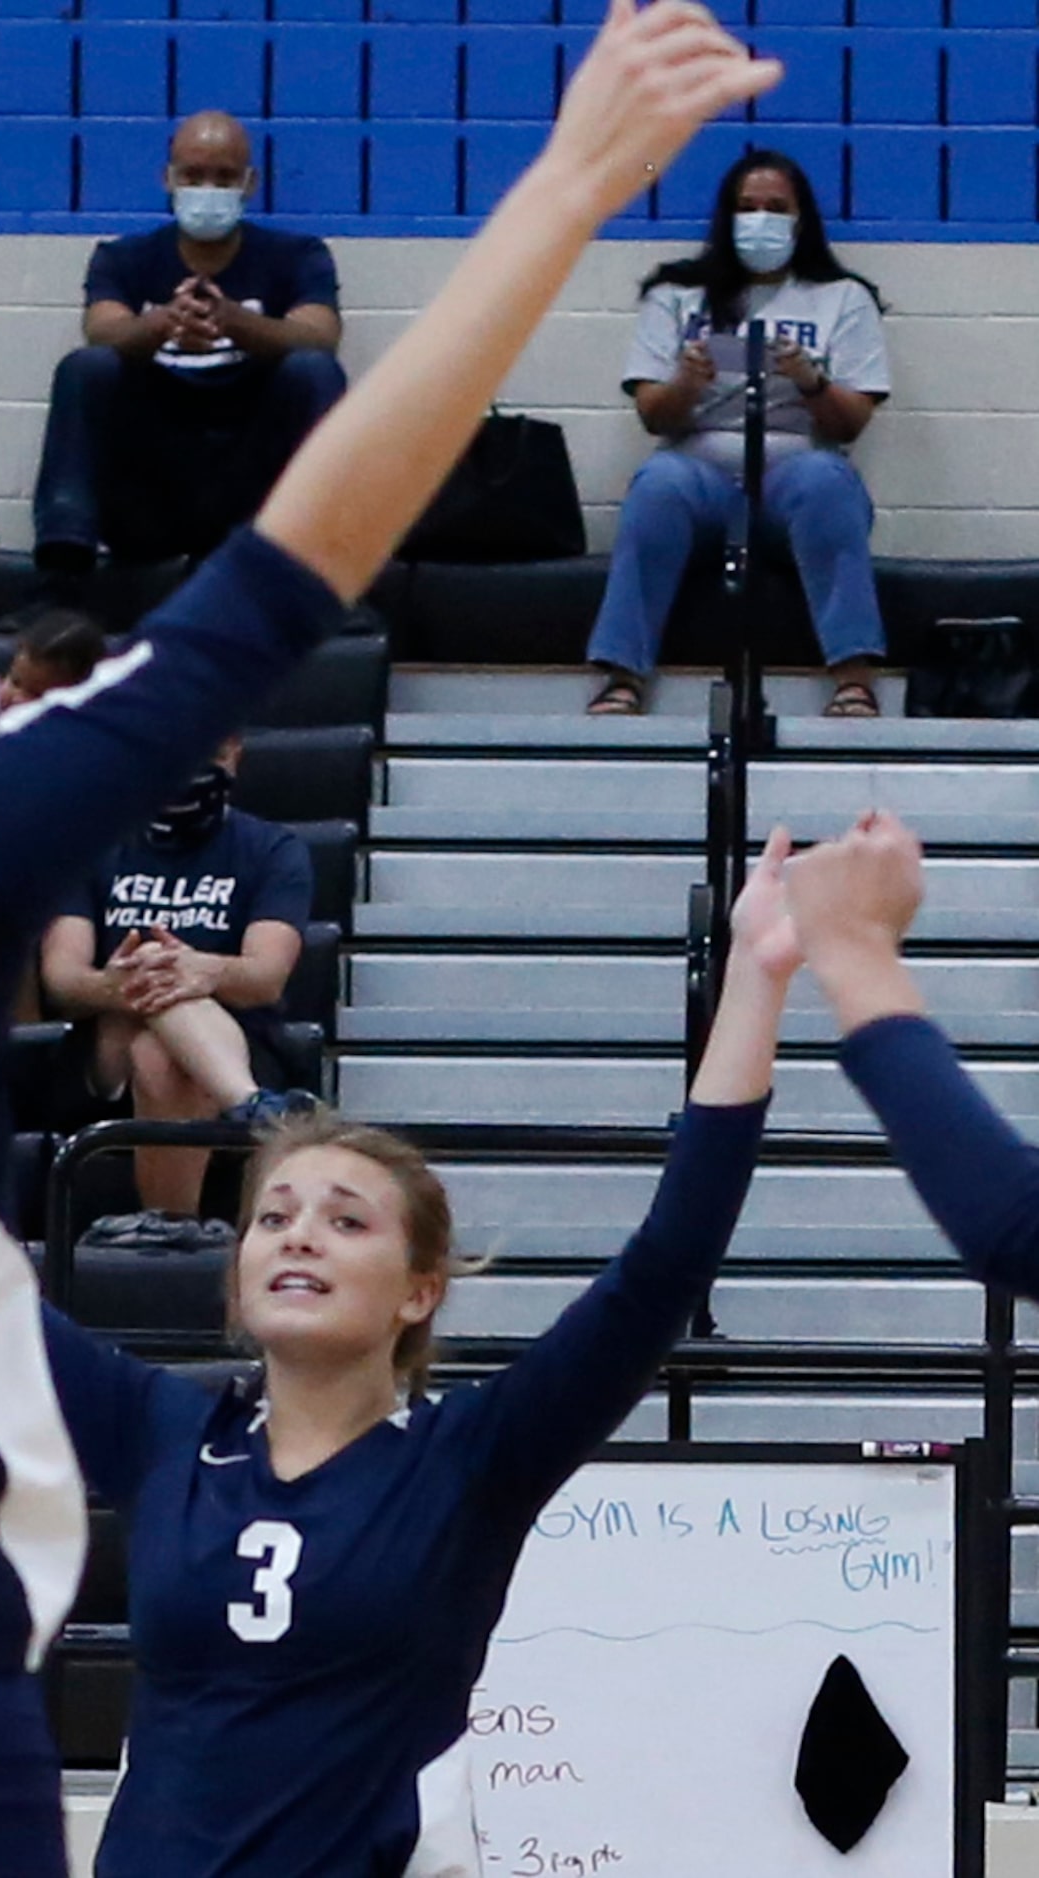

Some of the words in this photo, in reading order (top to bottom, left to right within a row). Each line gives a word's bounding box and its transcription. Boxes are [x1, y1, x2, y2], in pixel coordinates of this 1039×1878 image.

[111, 873, 236, 905] KELLER
[104, 907, 230, 931] VOLLEYBALL
[534, 1493, 638, 1540] GYM
[658, 1502, 694, 1538] IS
[718, 1497, 741, 1536] A
[761, 1501, 890, 1541] LOSING
[227, 1519, 303, 1643] 3
[469, 1702, 555, 1736] ens
